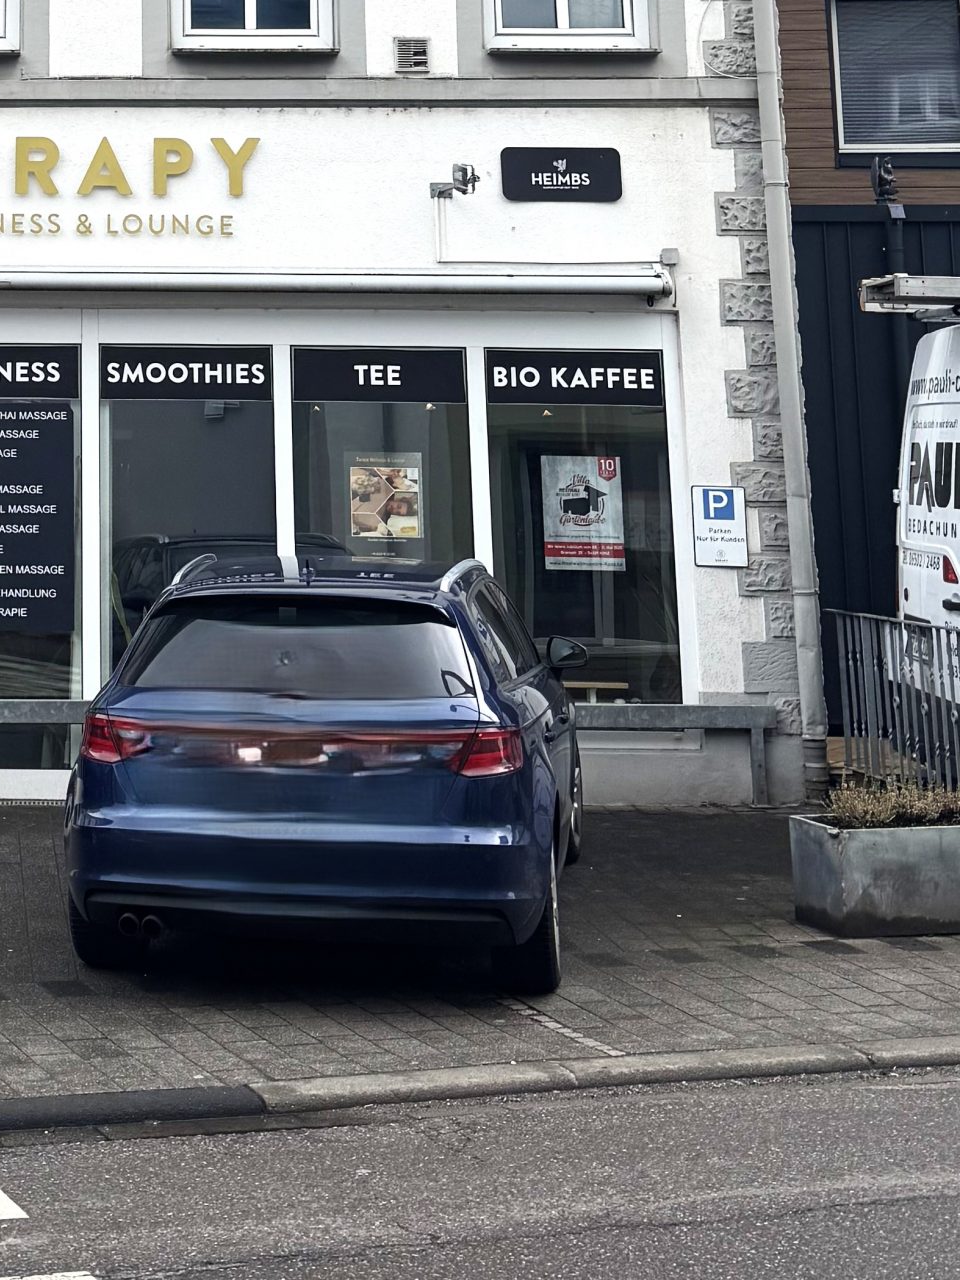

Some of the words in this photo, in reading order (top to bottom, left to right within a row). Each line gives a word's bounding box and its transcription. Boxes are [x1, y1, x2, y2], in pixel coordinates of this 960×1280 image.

[531, 172, 590, 186] HEIMBS
[76, 213, 93, 235] &
[106, 213, 235, 236] LOUNGE
[107, 362, 265, 384] SMOOTHIES
[353, 365, 401, 385] TEE
[493, 366, 541, 388] BIO
[551, 367, 655, 389] KAFFEE
[19, 411, 68, 420] MASSAGE
[600, 459, 614, 471] 10
[8, 505, 57, 514] MASSAGE
[708, 490, 728, 518] P
[15, 565, 65, 575] MASSAGE
